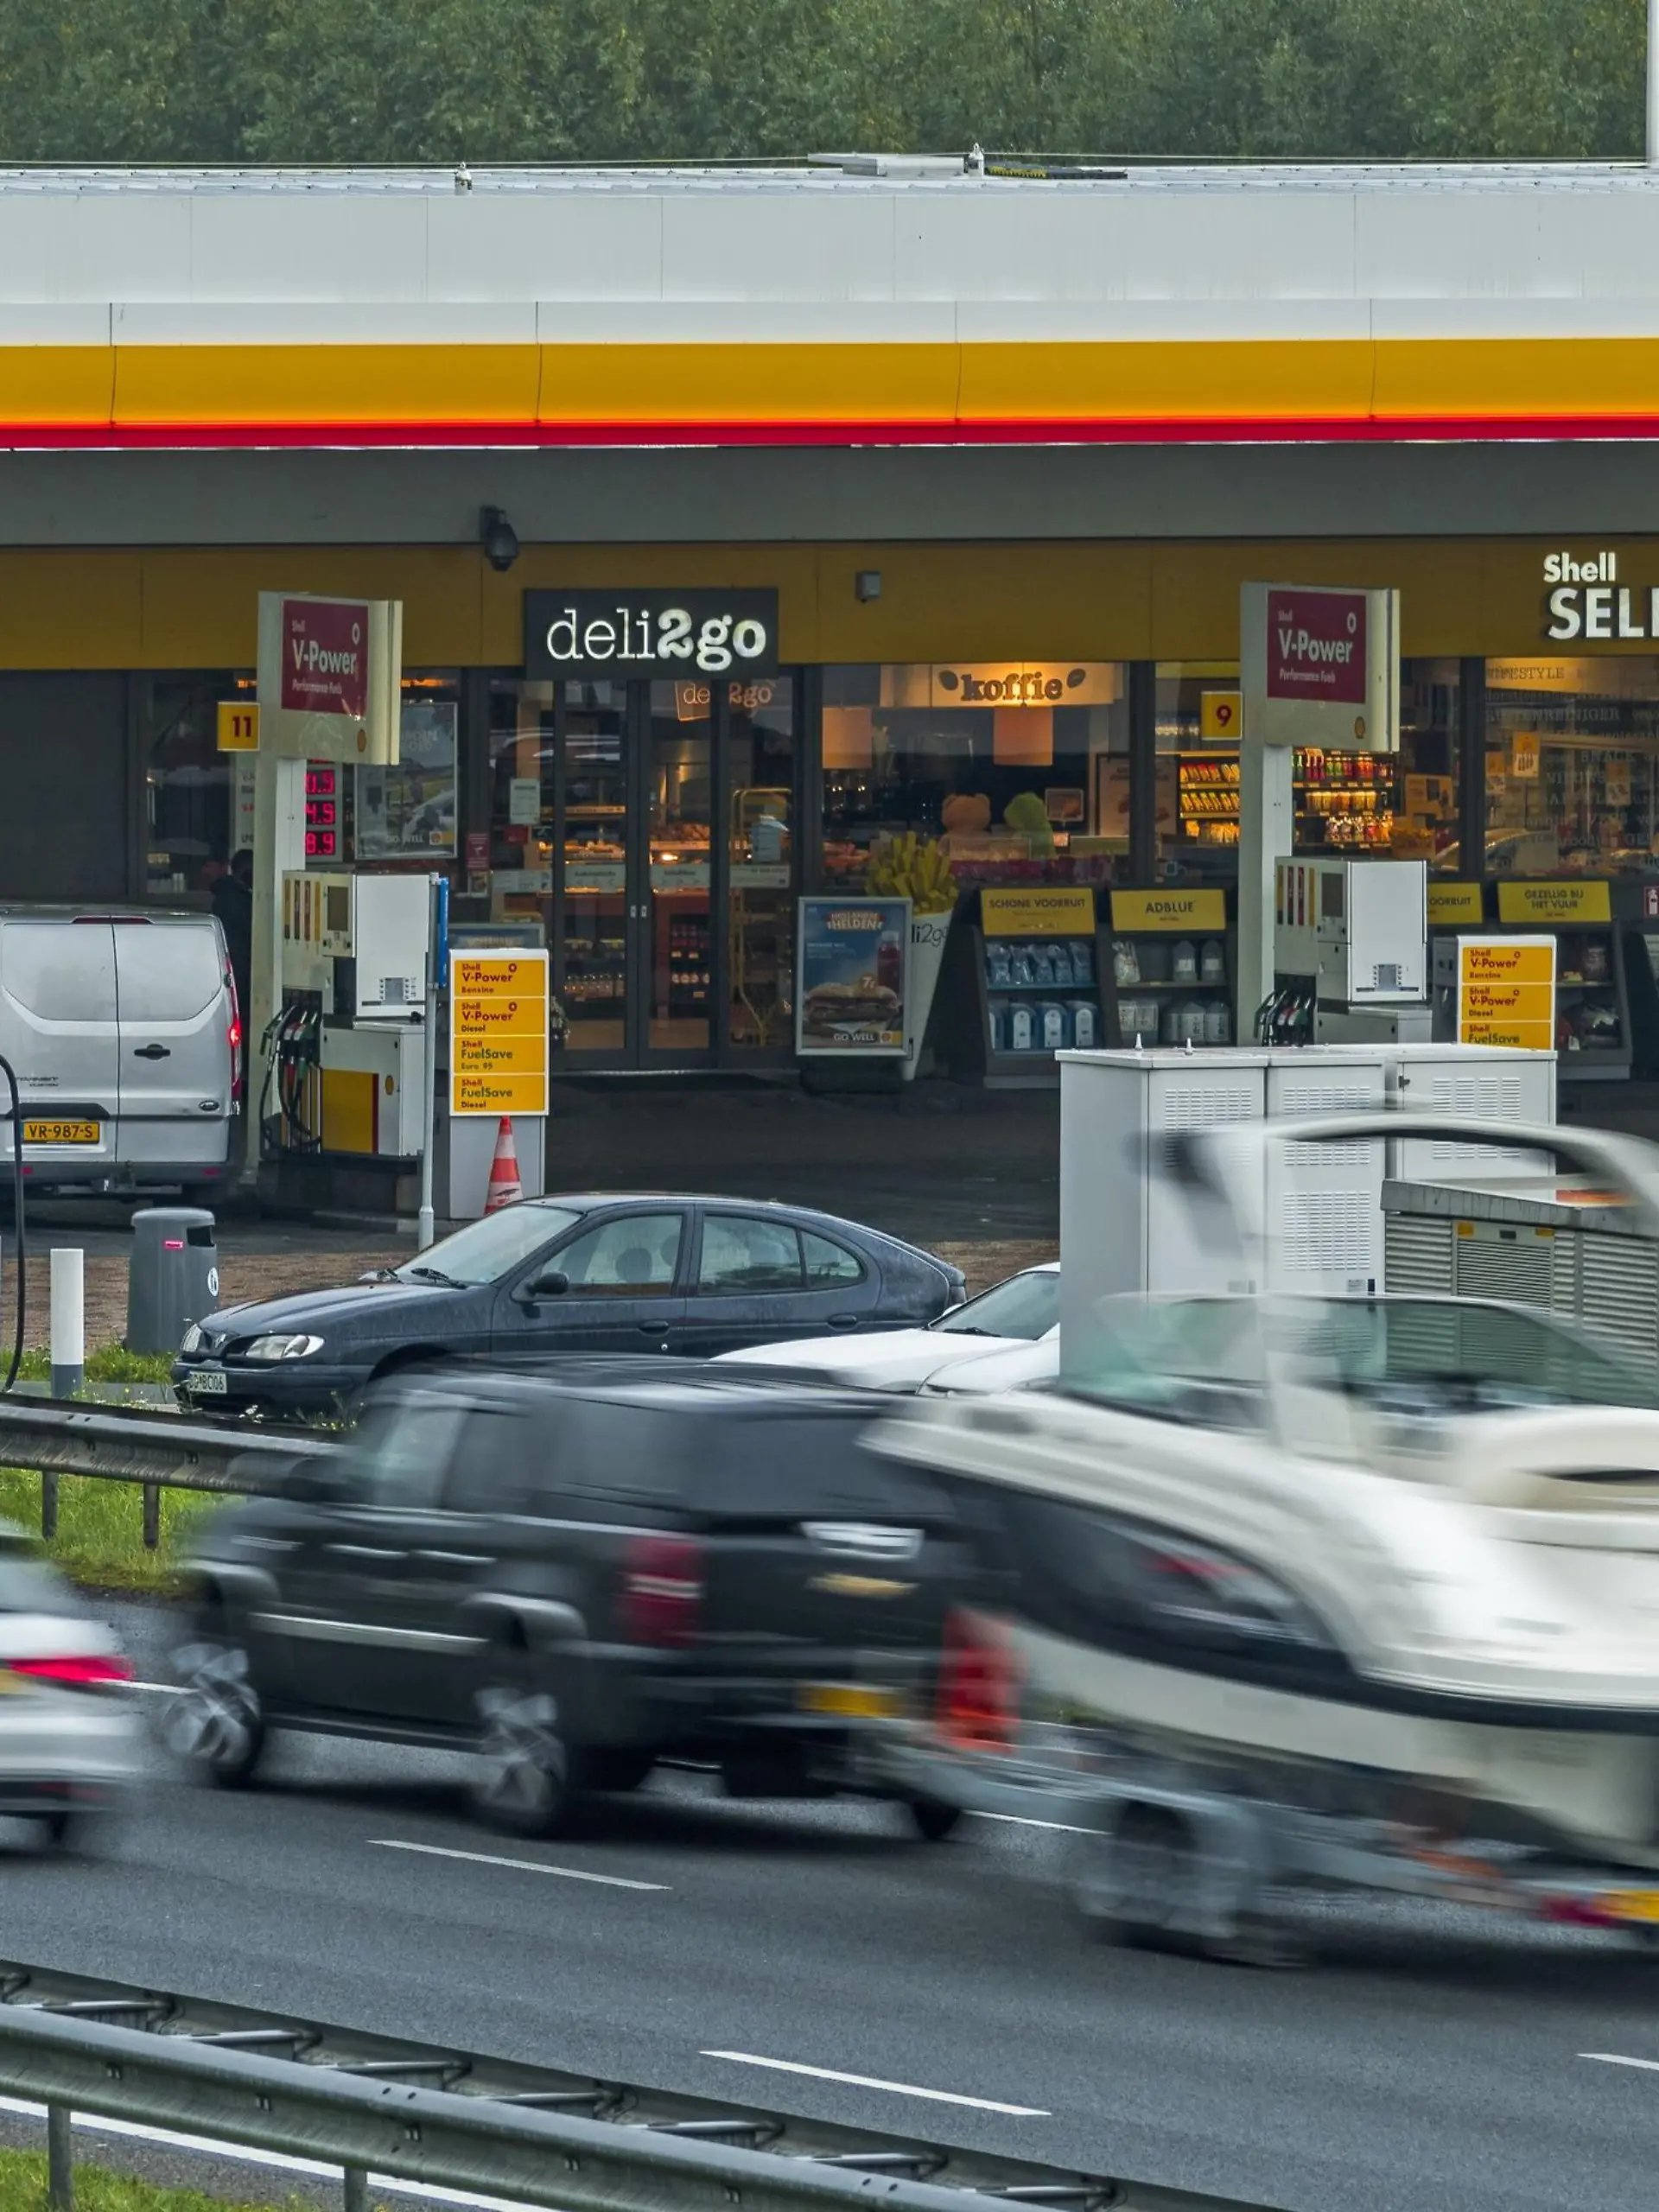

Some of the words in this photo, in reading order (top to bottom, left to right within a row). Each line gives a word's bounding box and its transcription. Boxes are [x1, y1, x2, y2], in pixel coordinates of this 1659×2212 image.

[1543, 551, 1617, 583] Shell
[546, 607, 767, 672] deli2go
[1278, 629, 1353, 664] V-Power
[292, 639, 357, 676] V-Power
[960, 672, 1064, 702] koffie
[683, 682, 772, 709] de2go
[1217, 704, 1232, 728] 9
[232, 715, 251, 738] 11
[1145, 901, 1194, 913] ADBLUE
[1428, 896, 1472, 906] OORRUIT
[911, 923, 949, 948] li2g
[1470, 958, 1517, 969] V-Power
[462, 972, 513, 983] V-Power
[1469, 987, 1491, 995] Shell
[1470, 996, 1517, 1006] V-Power
[462, 1011, 514, 1022] V-Power
[1468, 1033, 1520, 1044] FuelSave
[461, 1048, 513, 1059] FuelSave
[461, 1087, 513, 1098] FuelSave
[29, 1124, 93, 1138] VR-987-S
